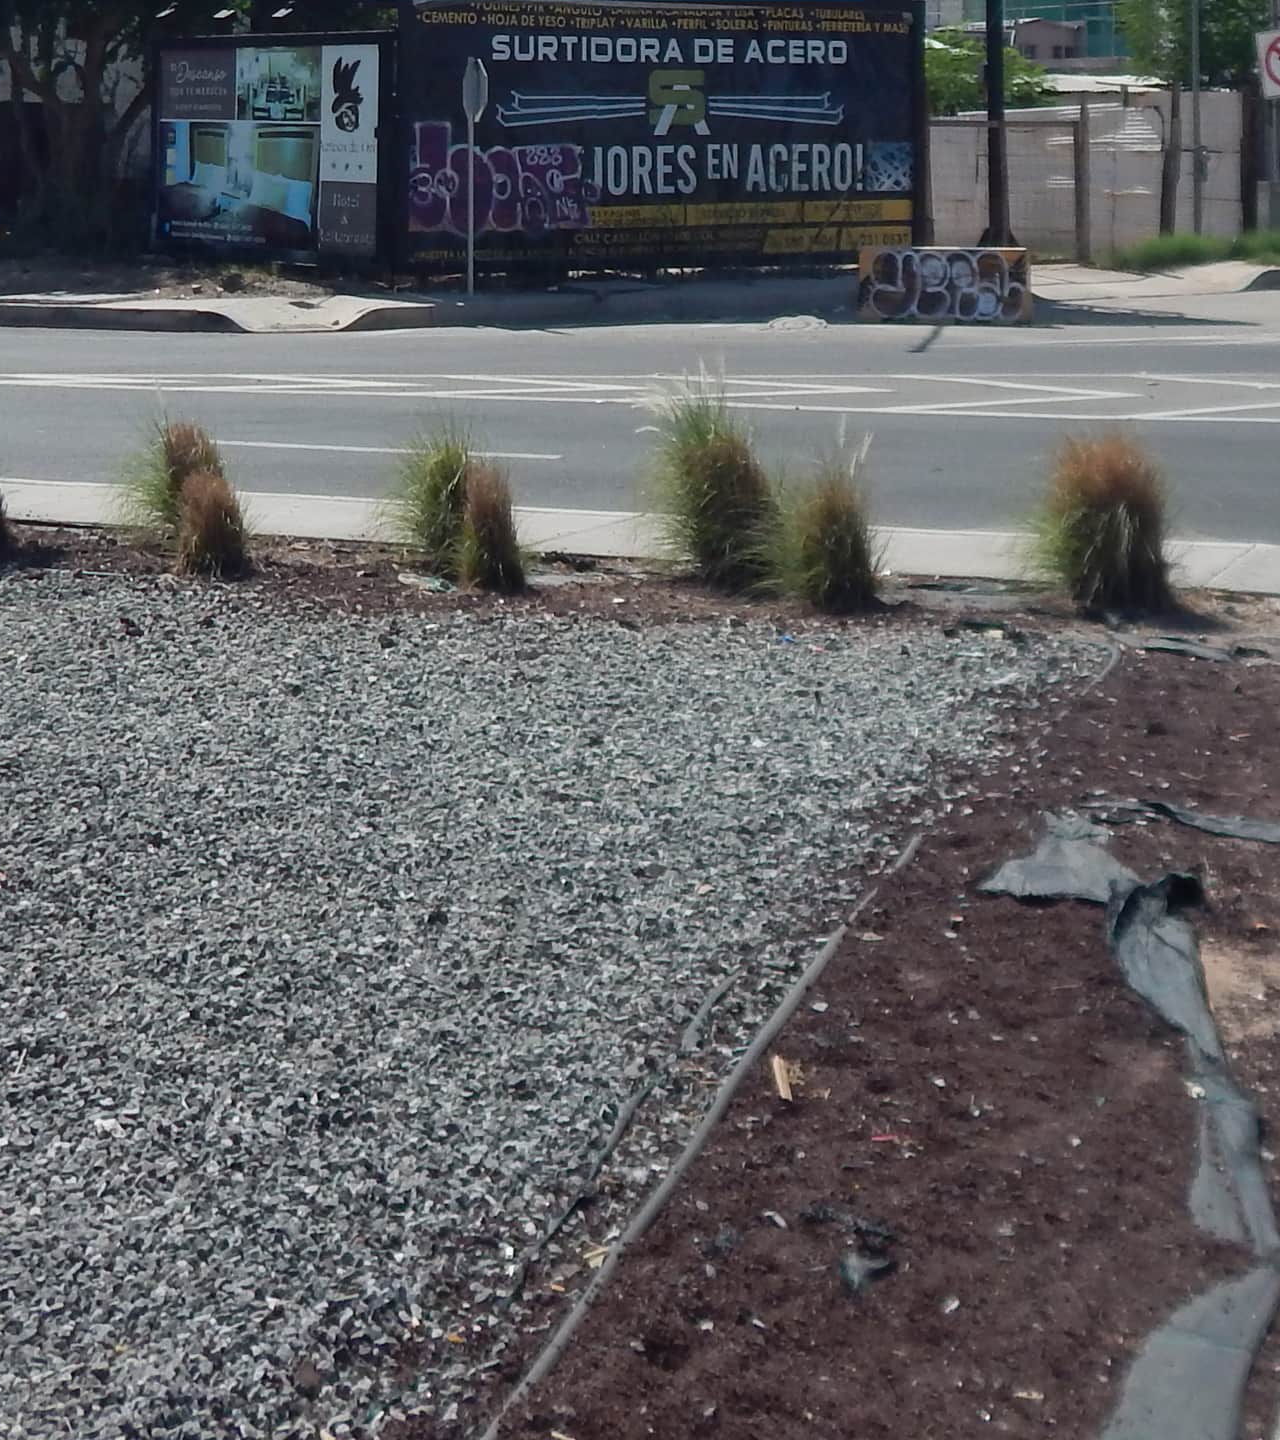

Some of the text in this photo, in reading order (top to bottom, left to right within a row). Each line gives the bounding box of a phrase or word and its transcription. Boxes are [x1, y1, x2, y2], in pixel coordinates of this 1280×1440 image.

[422, 12, 477, 25] CEMENTO
[487, 13, 518, 25] HOJA
[521, 14, 535, 26] DE
[539, 15, 567, 28] YESO
[575, 17, 616, 29] TRIPLAY
[626, 17, 668, 29] VARILLA
[716, 18, 759, 31] SOLERAS
[491, 34, 848, 65] SURTIDORA DE ACERO
[707, 143, 739, 180] EN
[746, 142, 864, 193] ACERO!
